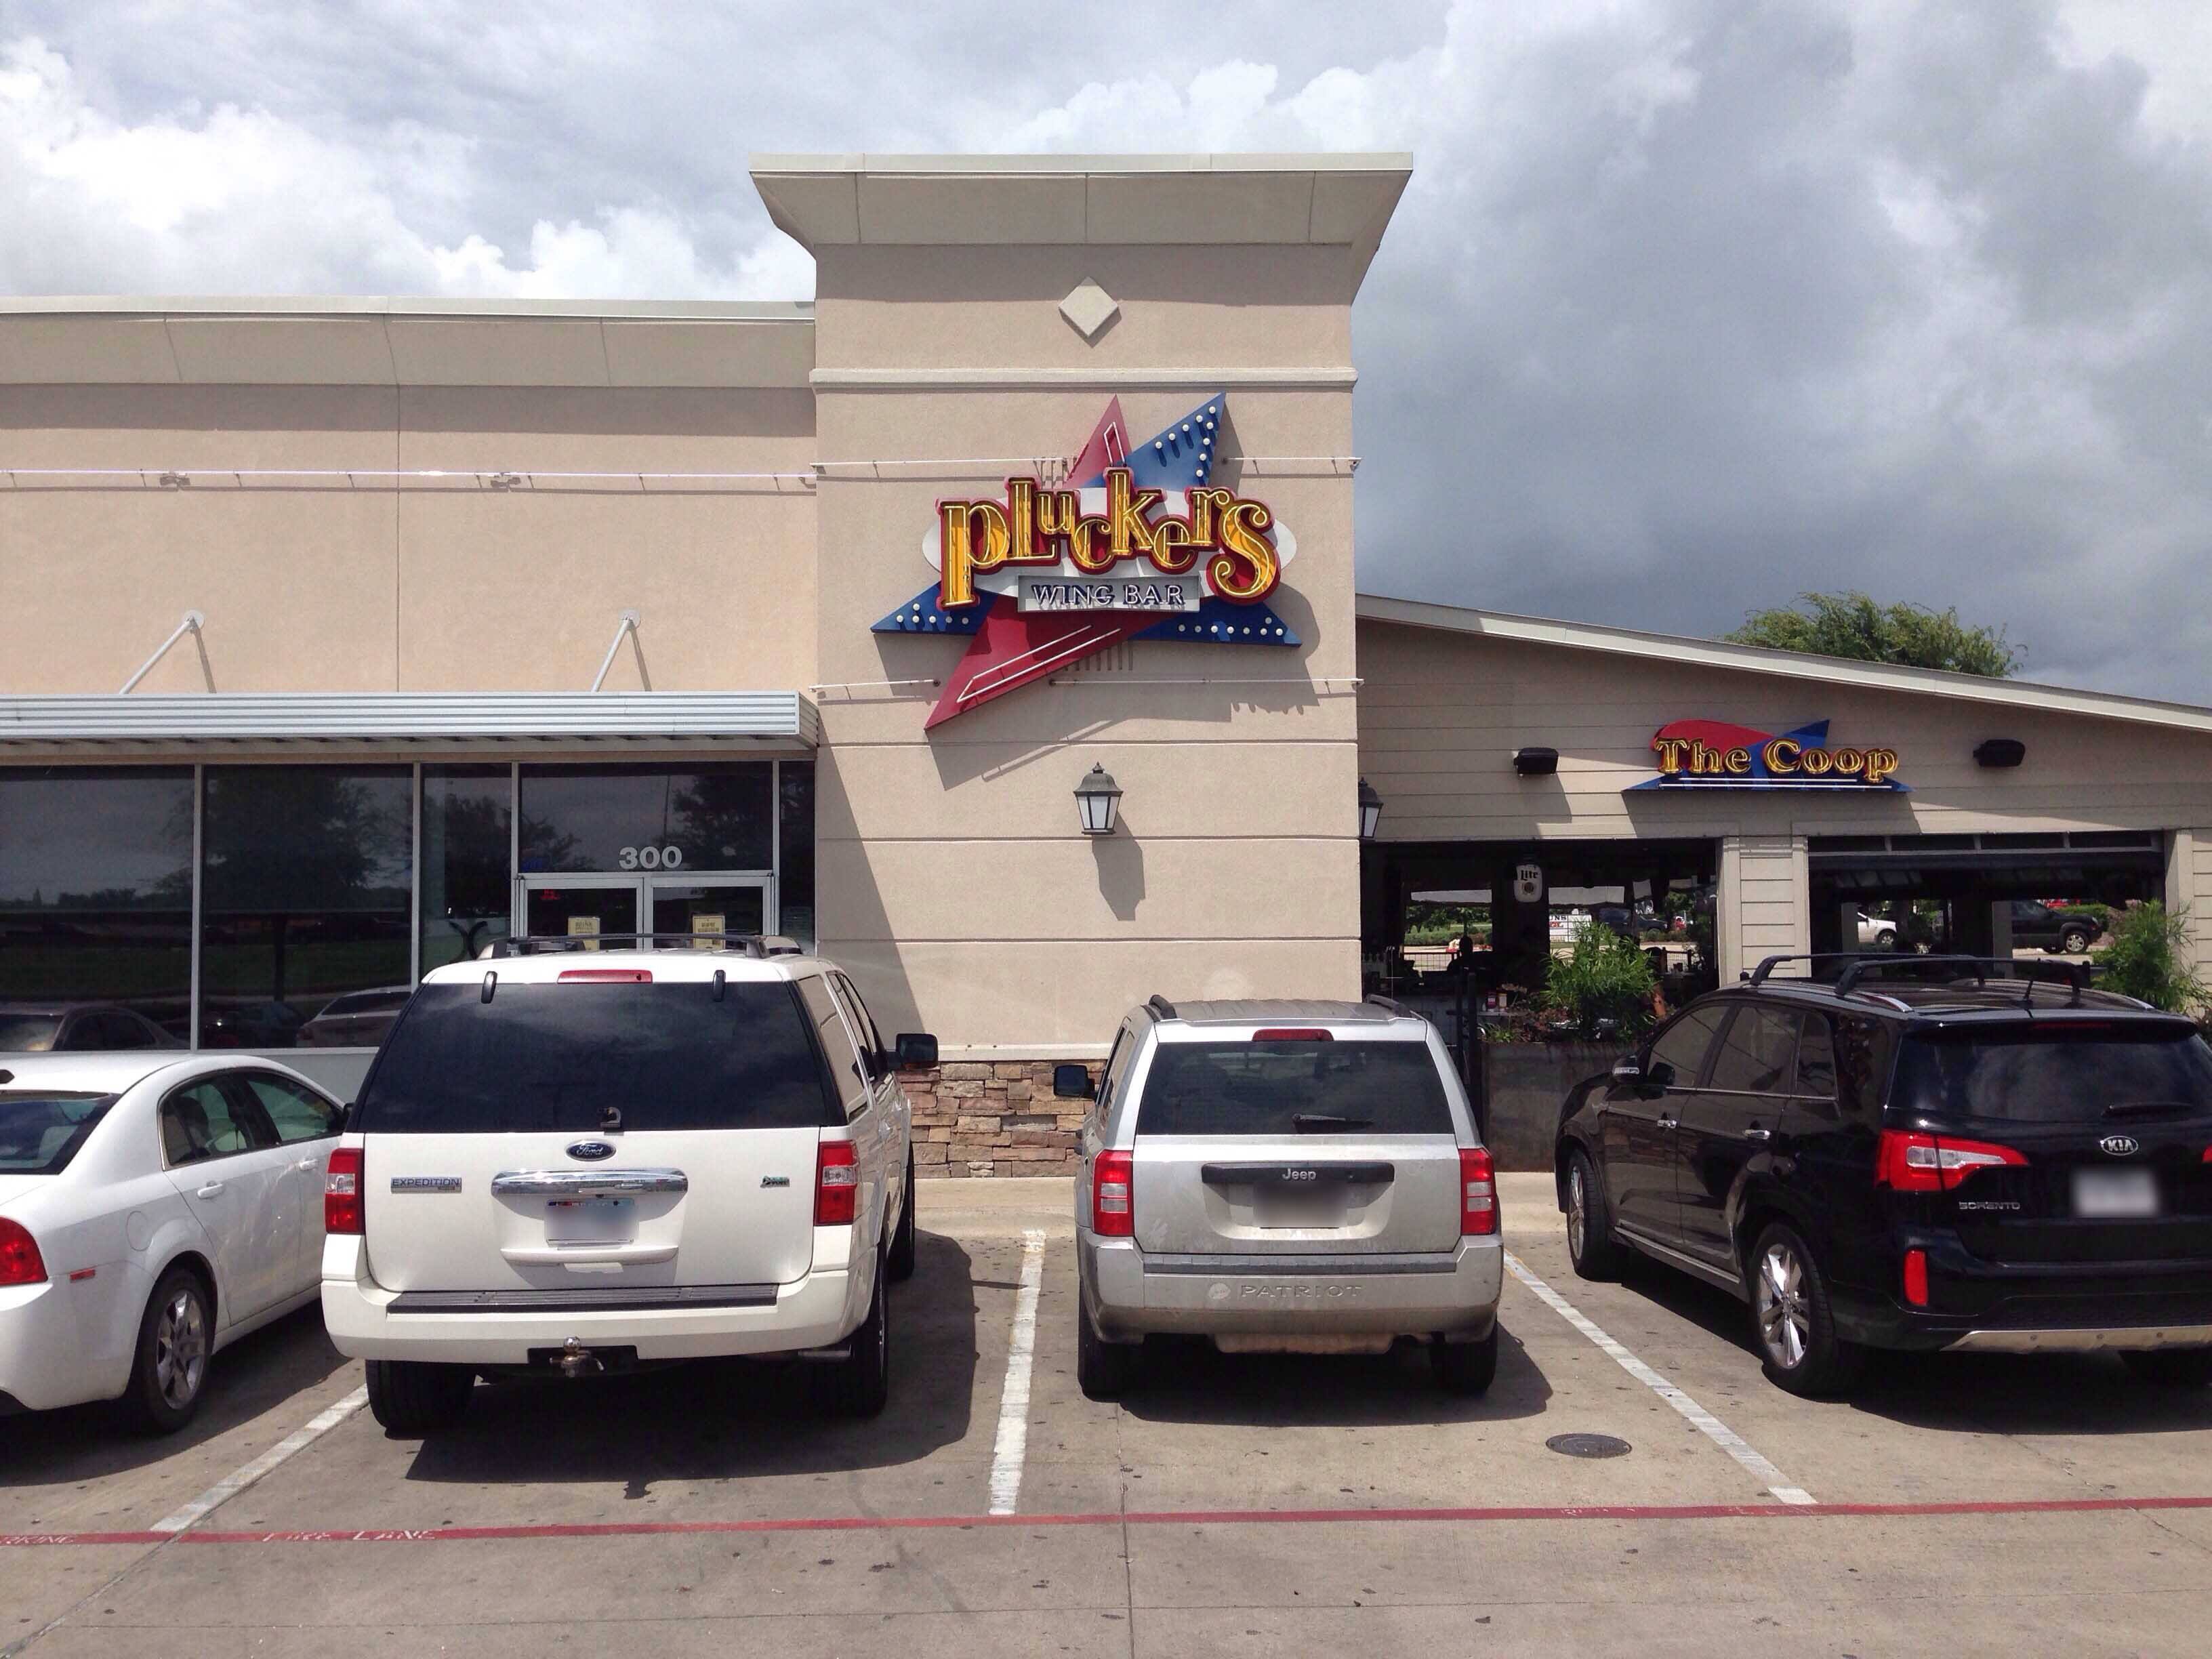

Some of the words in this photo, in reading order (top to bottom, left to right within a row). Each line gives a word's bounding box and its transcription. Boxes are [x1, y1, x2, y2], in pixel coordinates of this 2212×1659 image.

[1032, 585, 1115, 605] WING
[1123, 585, 1185, 605] BAR
[1654, 737, 1752, 774] The
[1763, 738, 1900, 783] Coop
[619, 846, 682, 869] 300
[1521, 870, 1538, 880] Lite
[576, 1144, 604, 1155] Ford
[2108, 1139, 2134, 1151] KIA
[1282, 1168, 1317, 1181] Jeep
[392, 1178, 460, 1187] EXPEDITION
[1959, 1202, 2021, 1210] SORENTO
[1241, 1285, 1361, 1297] PATRIOT
